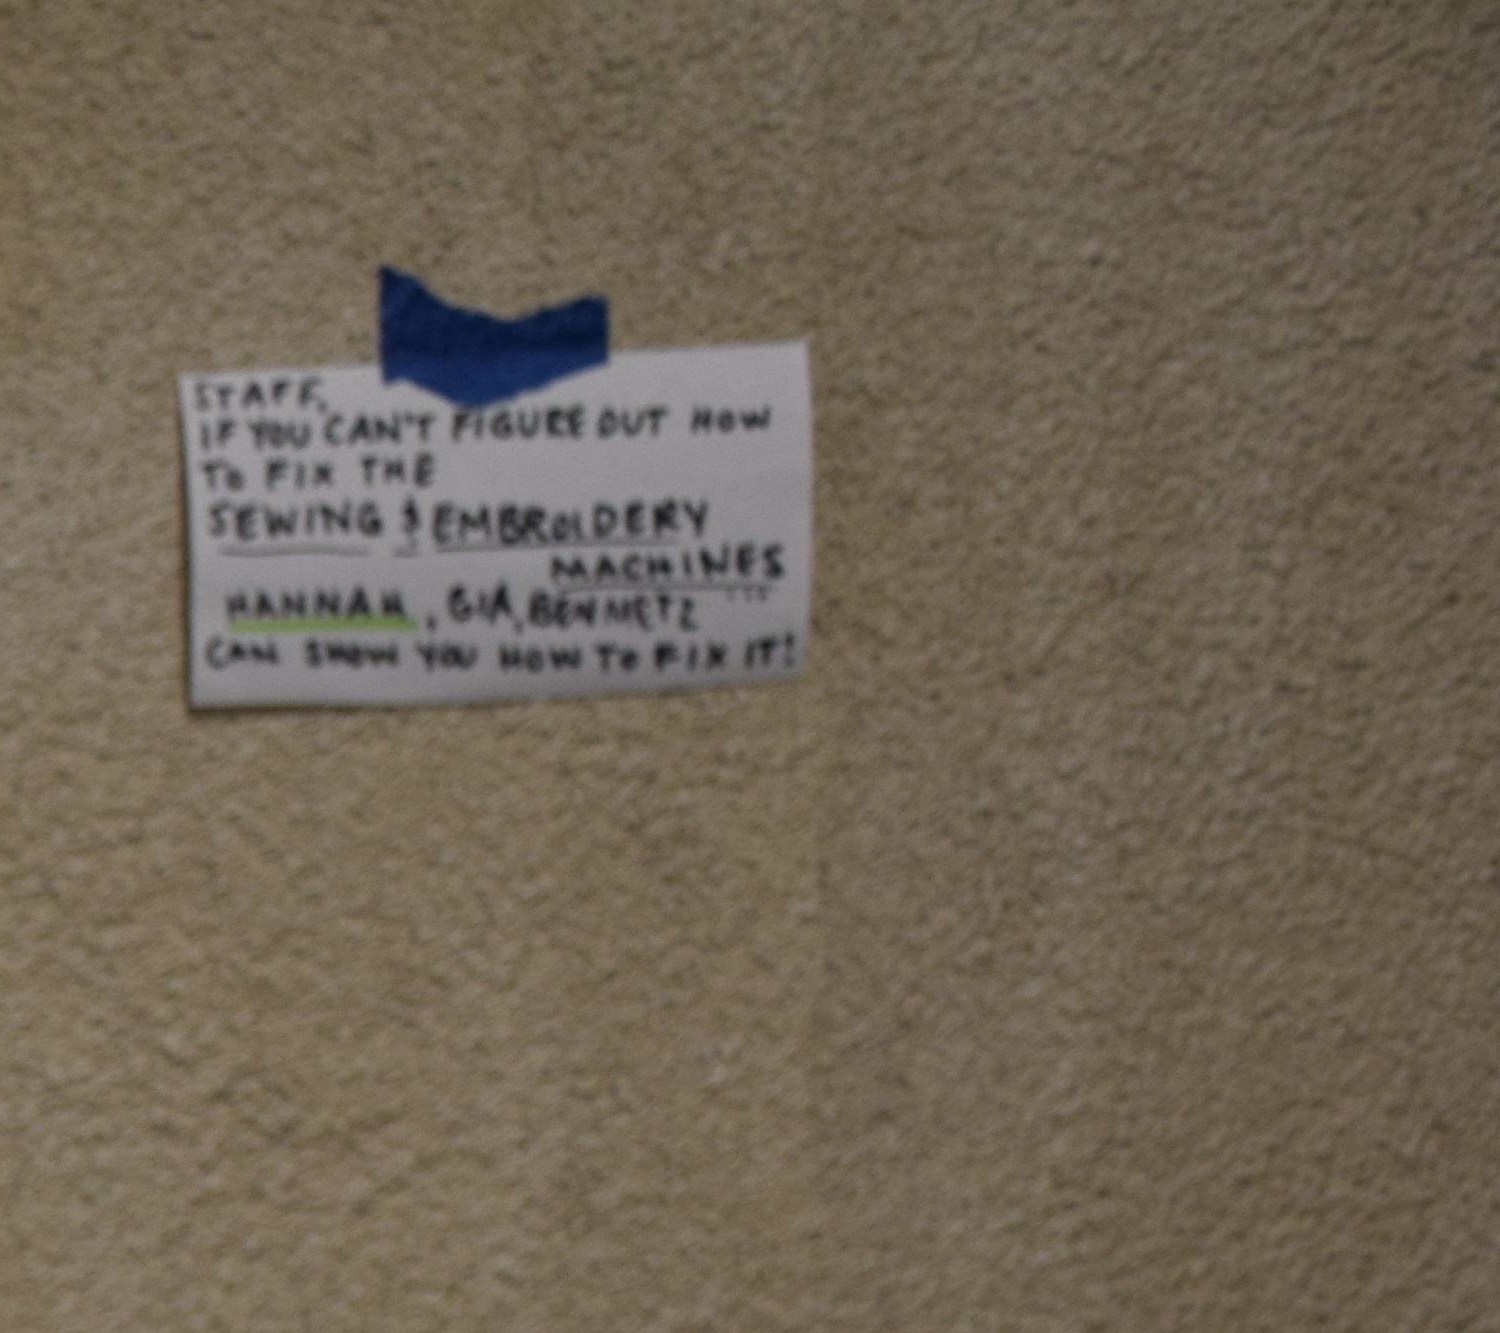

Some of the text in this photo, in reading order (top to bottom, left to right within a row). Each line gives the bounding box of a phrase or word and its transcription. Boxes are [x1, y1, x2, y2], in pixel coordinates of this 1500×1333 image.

[201, 403, 772, 449] IF YOU CAN'T FIGURE OUT HOW
[203, 452, 436, 491] TO FIX THE
[210, 502, 384, 541] SEWING
[433, 498, 710, 545] EMBROIDERY
[550, 540, 786, 581] MACHINES
[205, 636, 280, 670] CAN
[304, 638, 399, 669] SHOW
[415, 641, 478, 672] YOU
[498, 644, 582, 673] HOW
[597, 643, 638, 673] TO
[653, 642, 727, 672] FIX
